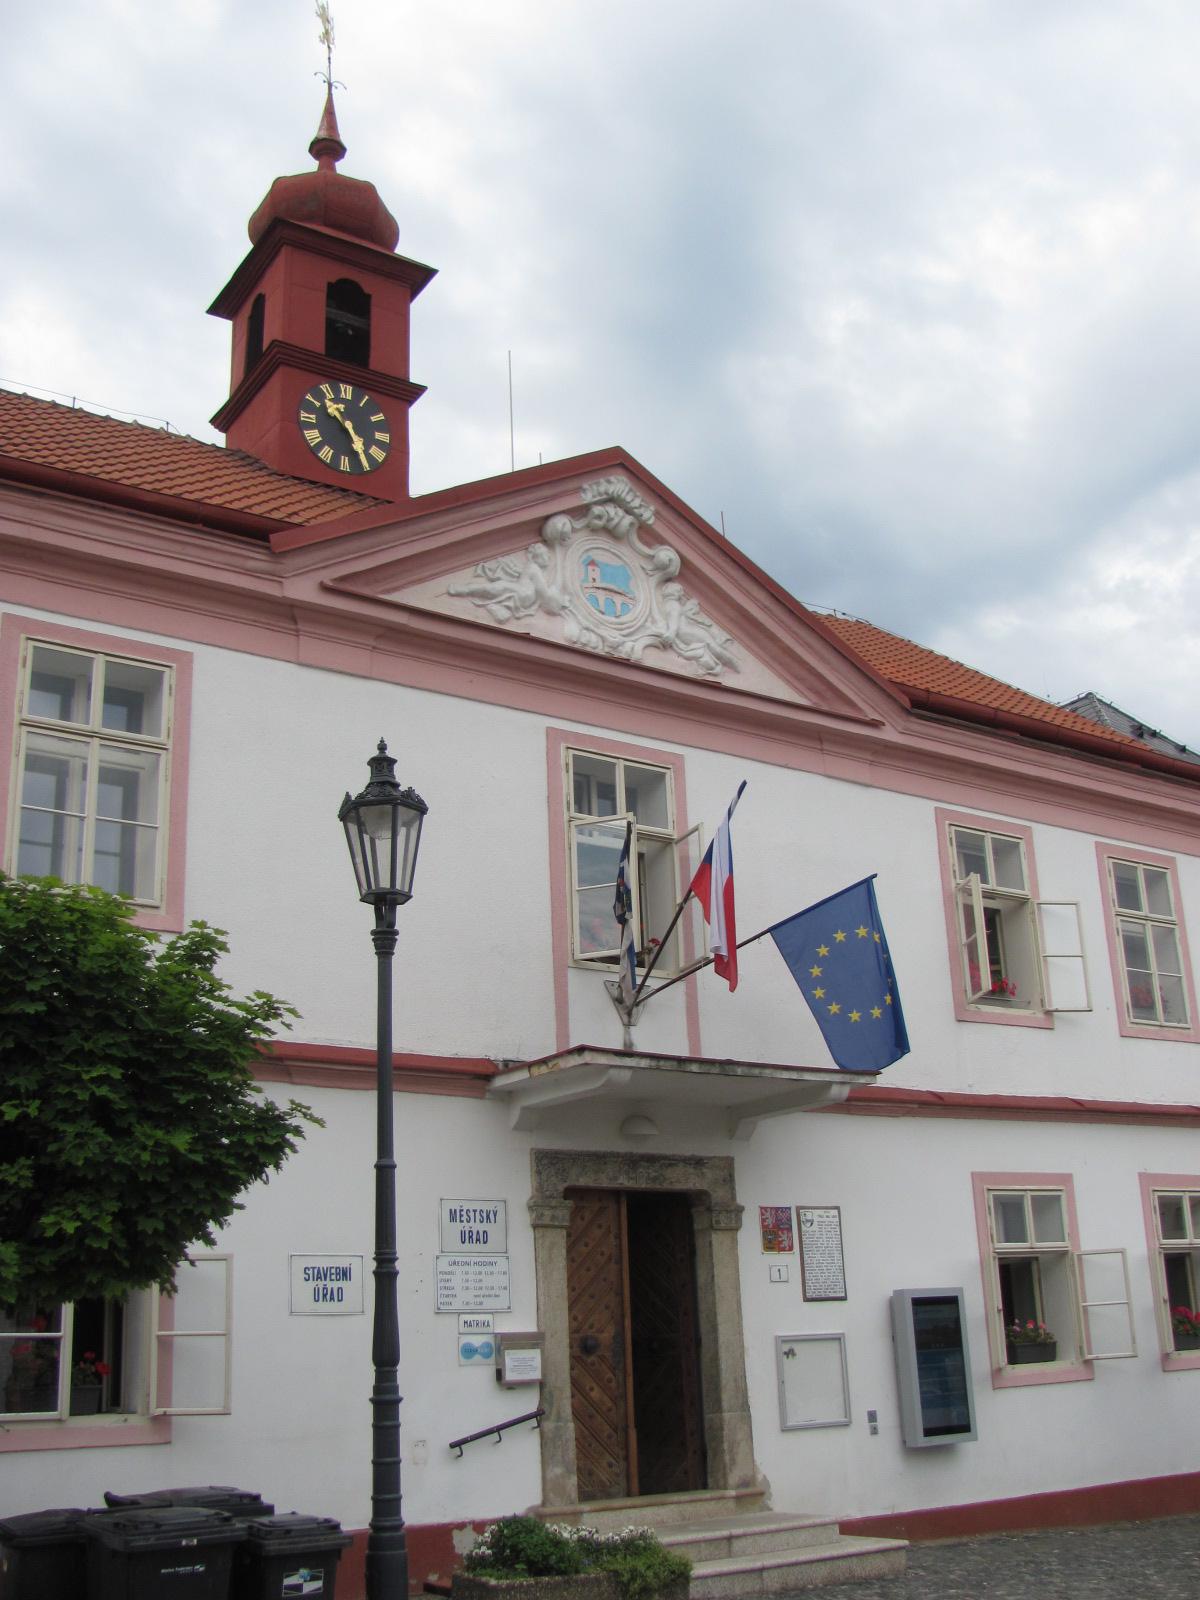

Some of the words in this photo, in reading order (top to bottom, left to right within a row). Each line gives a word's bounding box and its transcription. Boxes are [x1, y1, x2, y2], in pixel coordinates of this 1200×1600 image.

[340, 383, 353, 401] XII
[360, 395, 369, 407] I
[370, 412, 385, 423] II
[303, 429, 323, 447] VIII
[375, 431, 390, 443] III
[318, 445, 334, 464] VII
[340, 455, 351, 472] VI
[449, 1205, 498, 1224] MĚSTSKÝ
[460, 1225, 489, 1245] ÚŘAD
[303, 1263, 352, 1282] STAVEBNÍ
[313, 1284, 344, 1303] ÚŘAD
[463, 1319, 491, 1329] MATRIKA
